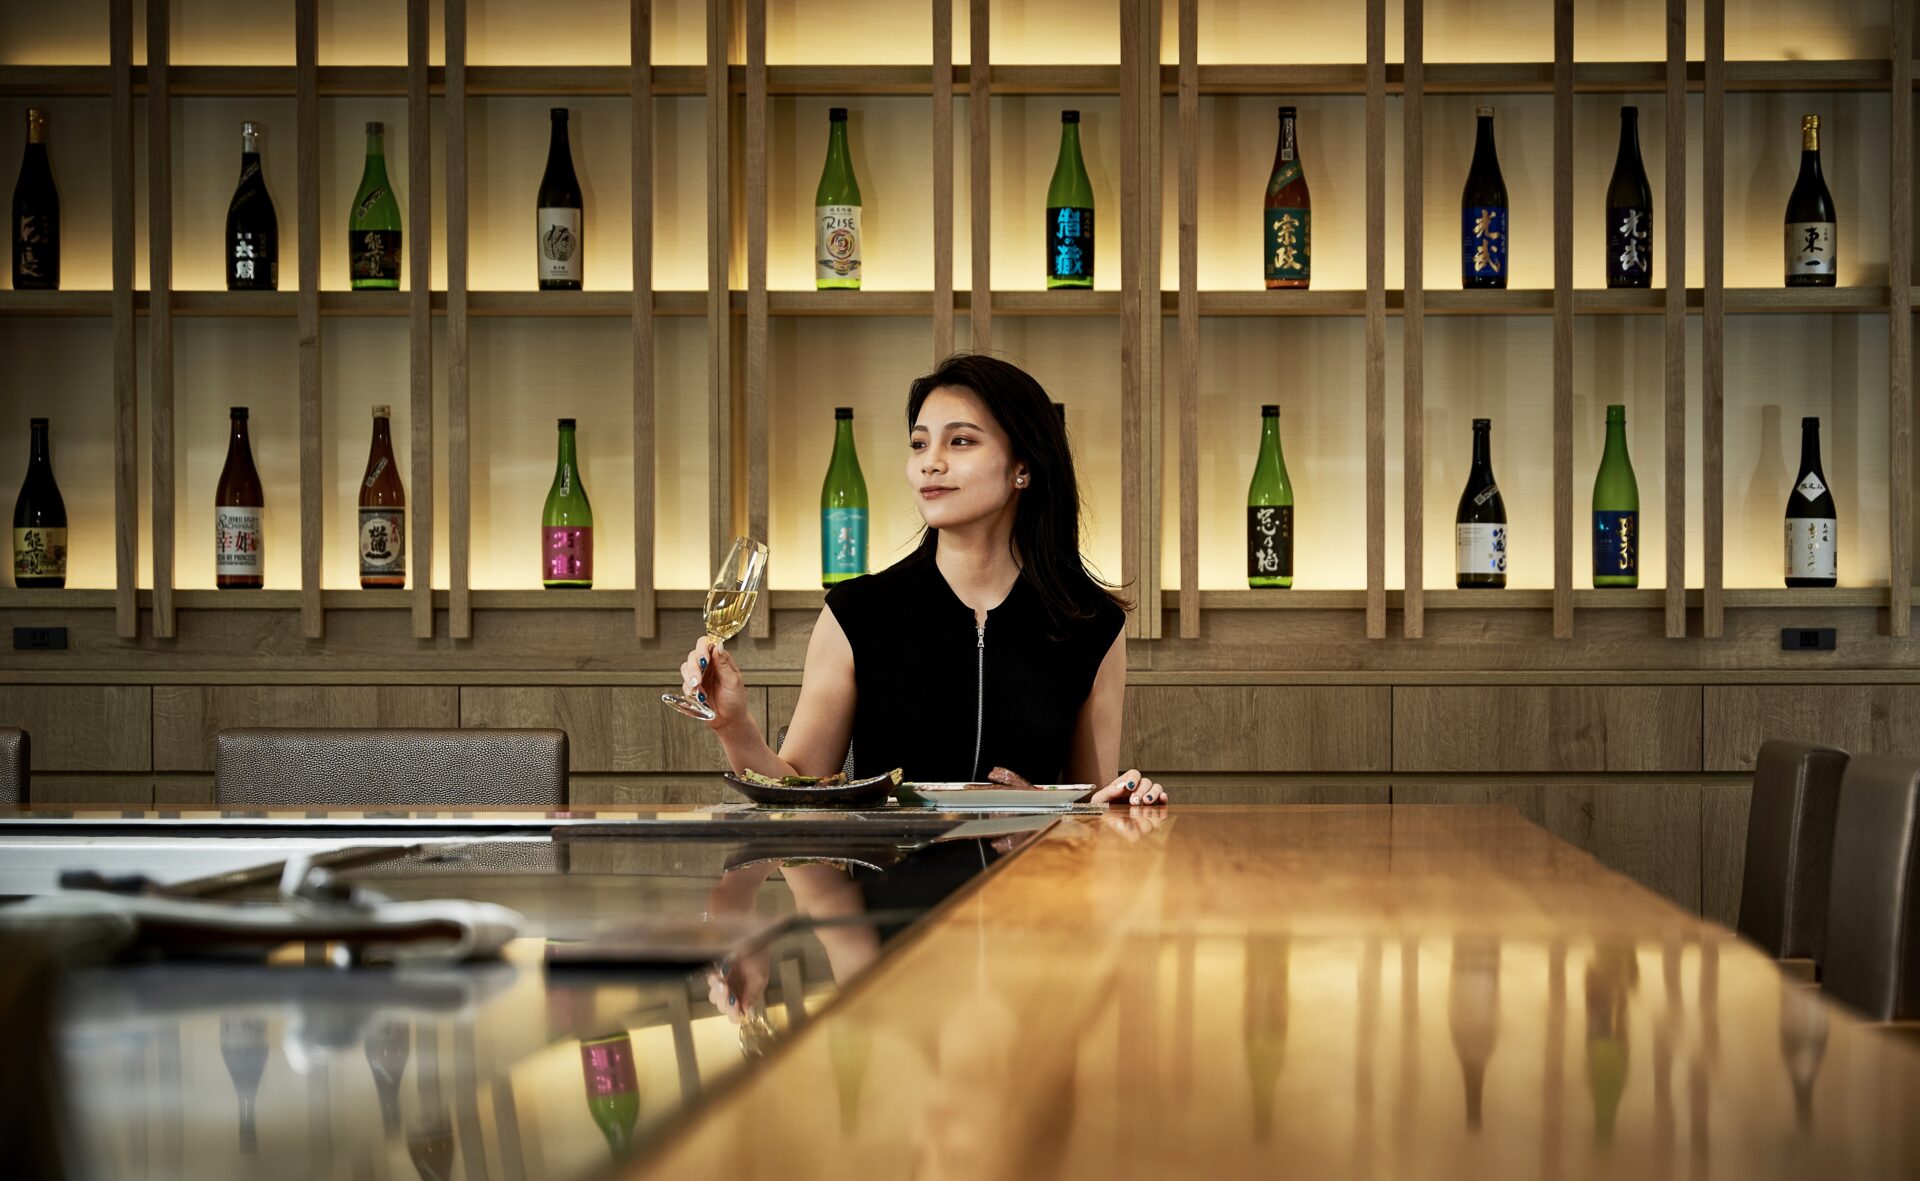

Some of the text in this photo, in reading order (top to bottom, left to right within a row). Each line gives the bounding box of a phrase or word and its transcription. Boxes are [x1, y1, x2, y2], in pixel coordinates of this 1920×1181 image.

[823, 216, 855, 230] RISE
[1273, 214, 1303, 270] 宗政
[1473, 209, 1501, 273] 光武
[1619, 209, 1647, 273] 光武
[1802, 226, 1824, 267] 東一
[1256, 508, 1280, 572] 窓乃梅
